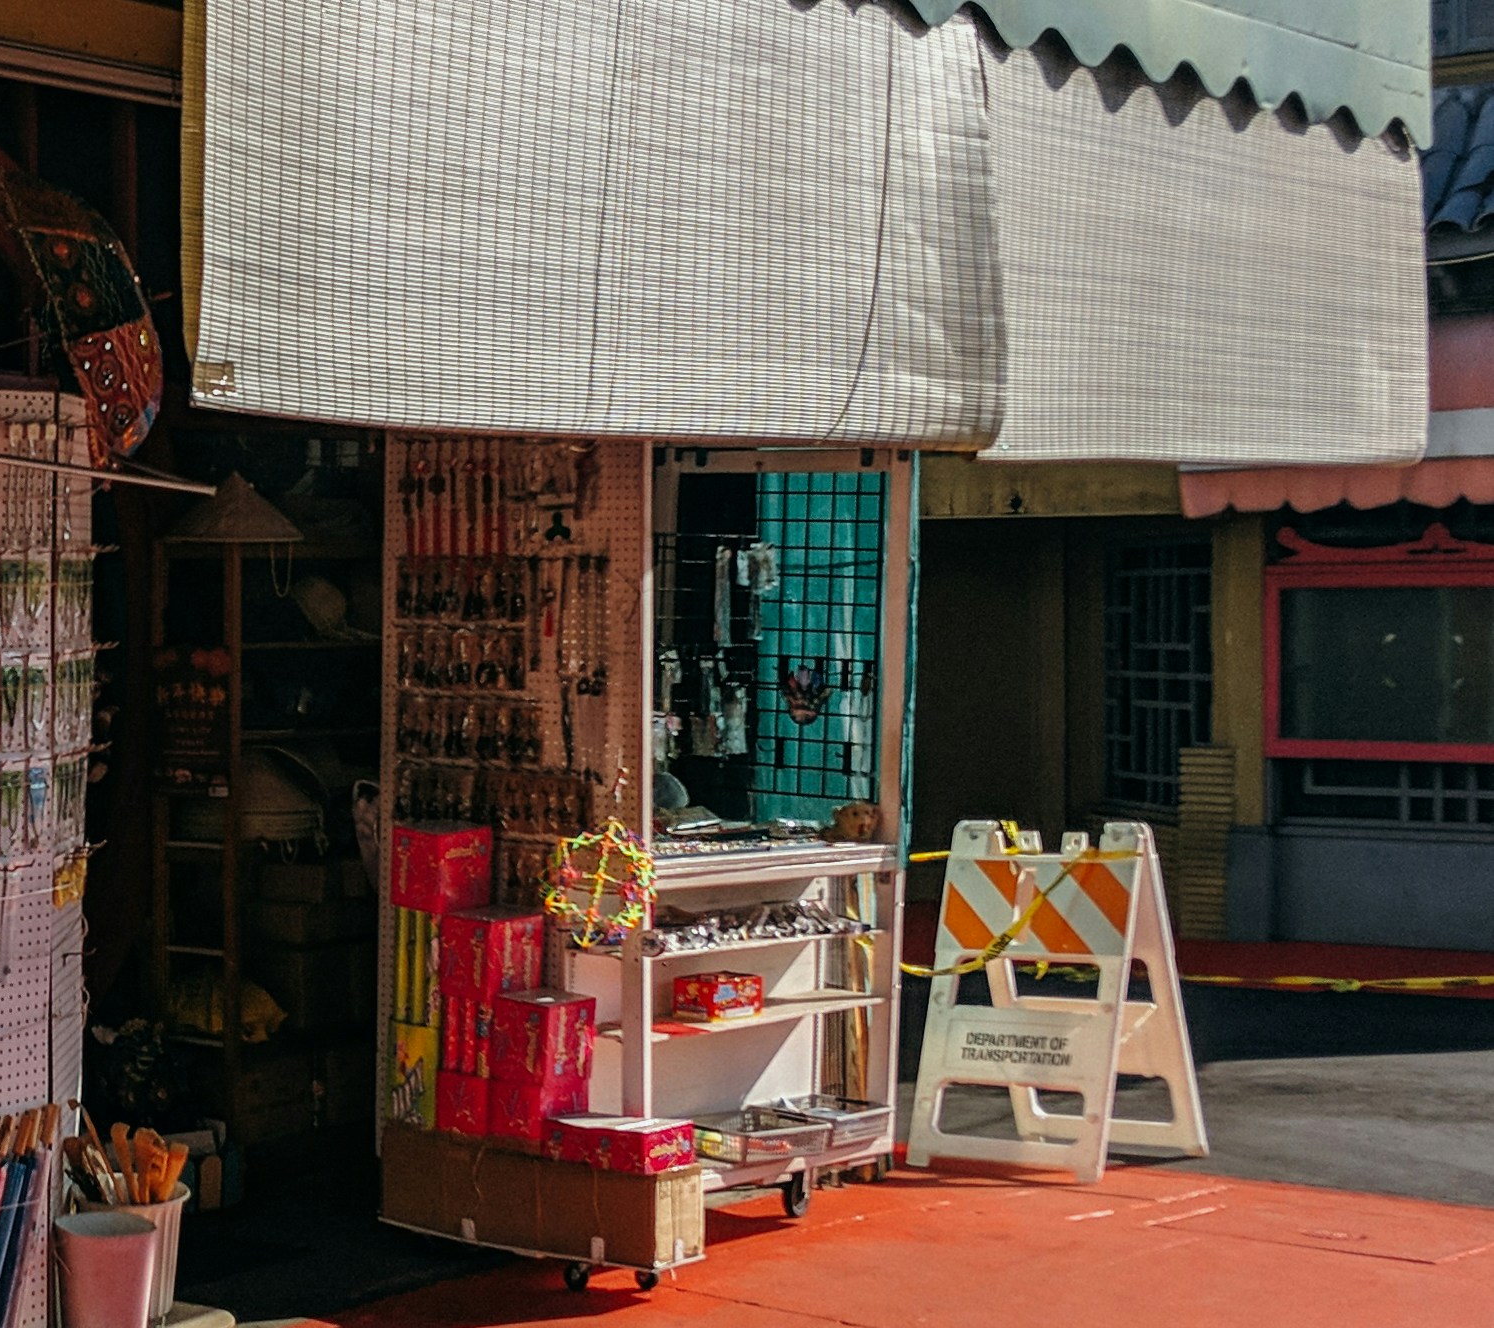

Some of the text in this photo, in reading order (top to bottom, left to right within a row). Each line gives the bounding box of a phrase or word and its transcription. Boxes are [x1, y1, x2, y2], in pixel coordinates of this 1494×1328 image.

[966, 1032, 1069, 1051] DEPARTMENT OF
[961, 1046, 1072, 1067] TRANSPORTATION
